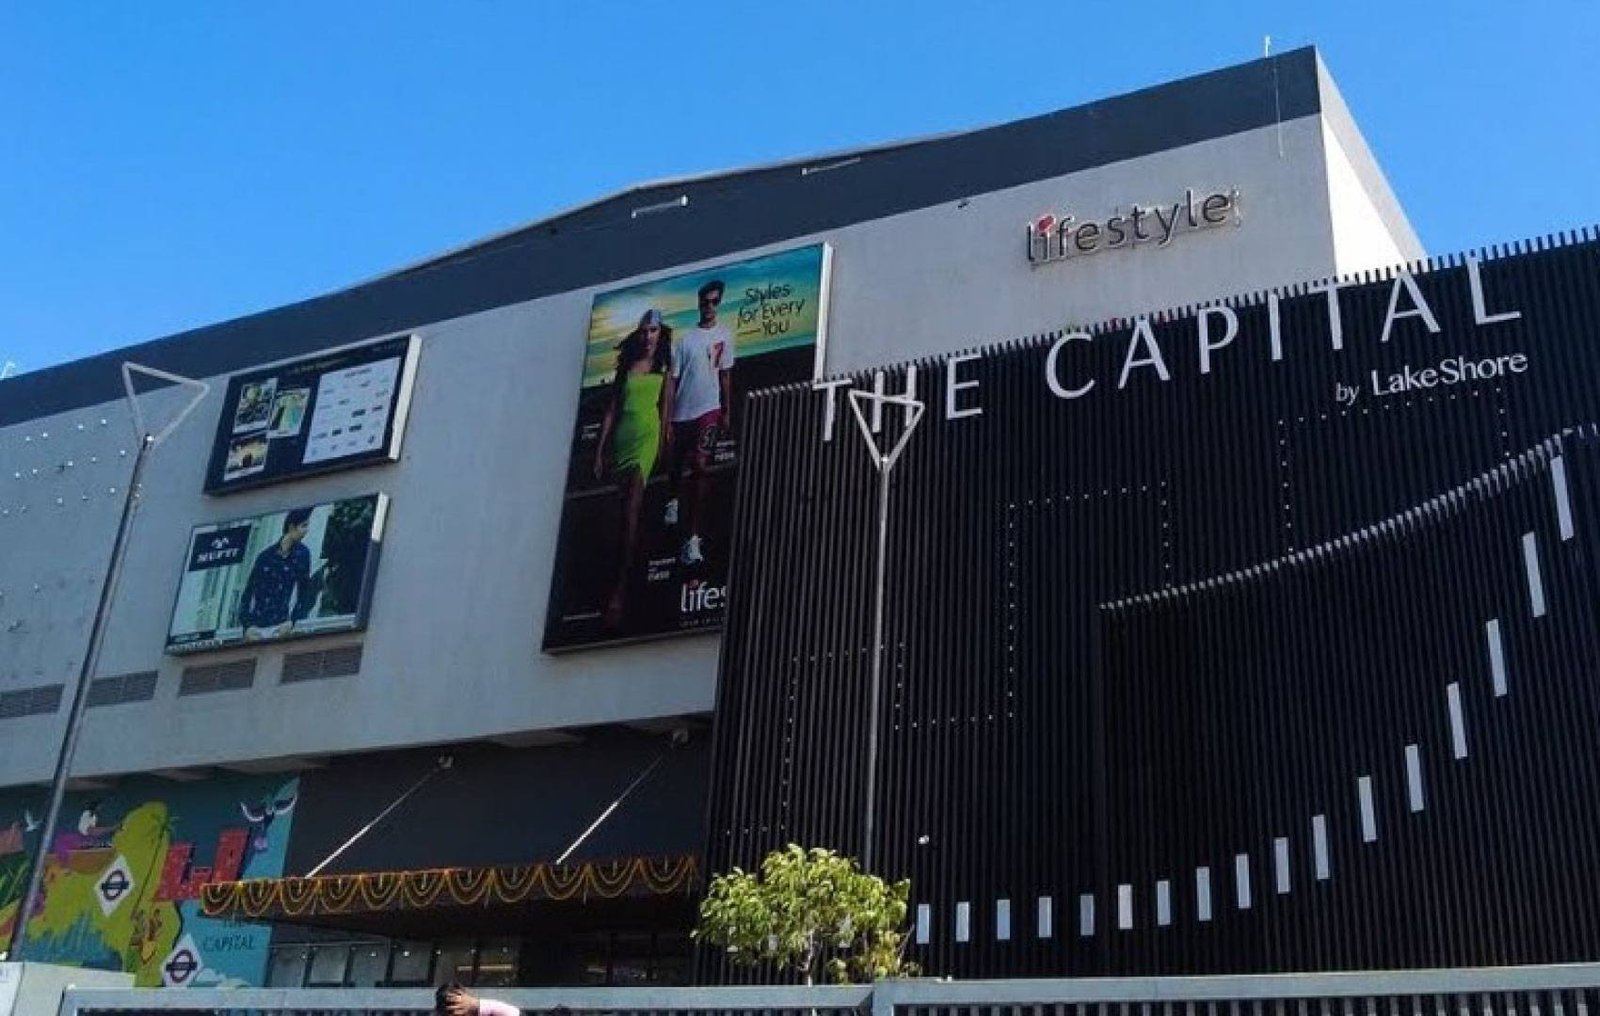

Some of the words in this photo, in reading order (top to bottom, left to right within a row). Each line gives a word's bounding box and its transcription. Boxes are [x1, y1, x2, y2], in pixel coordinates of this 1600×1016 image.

[1026, 188, 1231, 262] lifestyle
[737, 305, 758, 329] for
[761, 298, 806, 320] Every
[745, 283, 791, 305] Styles
[761, 319, 791, 335] You
[811, 352, 983, 441] THE
[1045, 255, 1522, 399] CAPITAL
[1335, 382, 1360, 406] by
[1371, 353, 1529, 396] LakeShore
